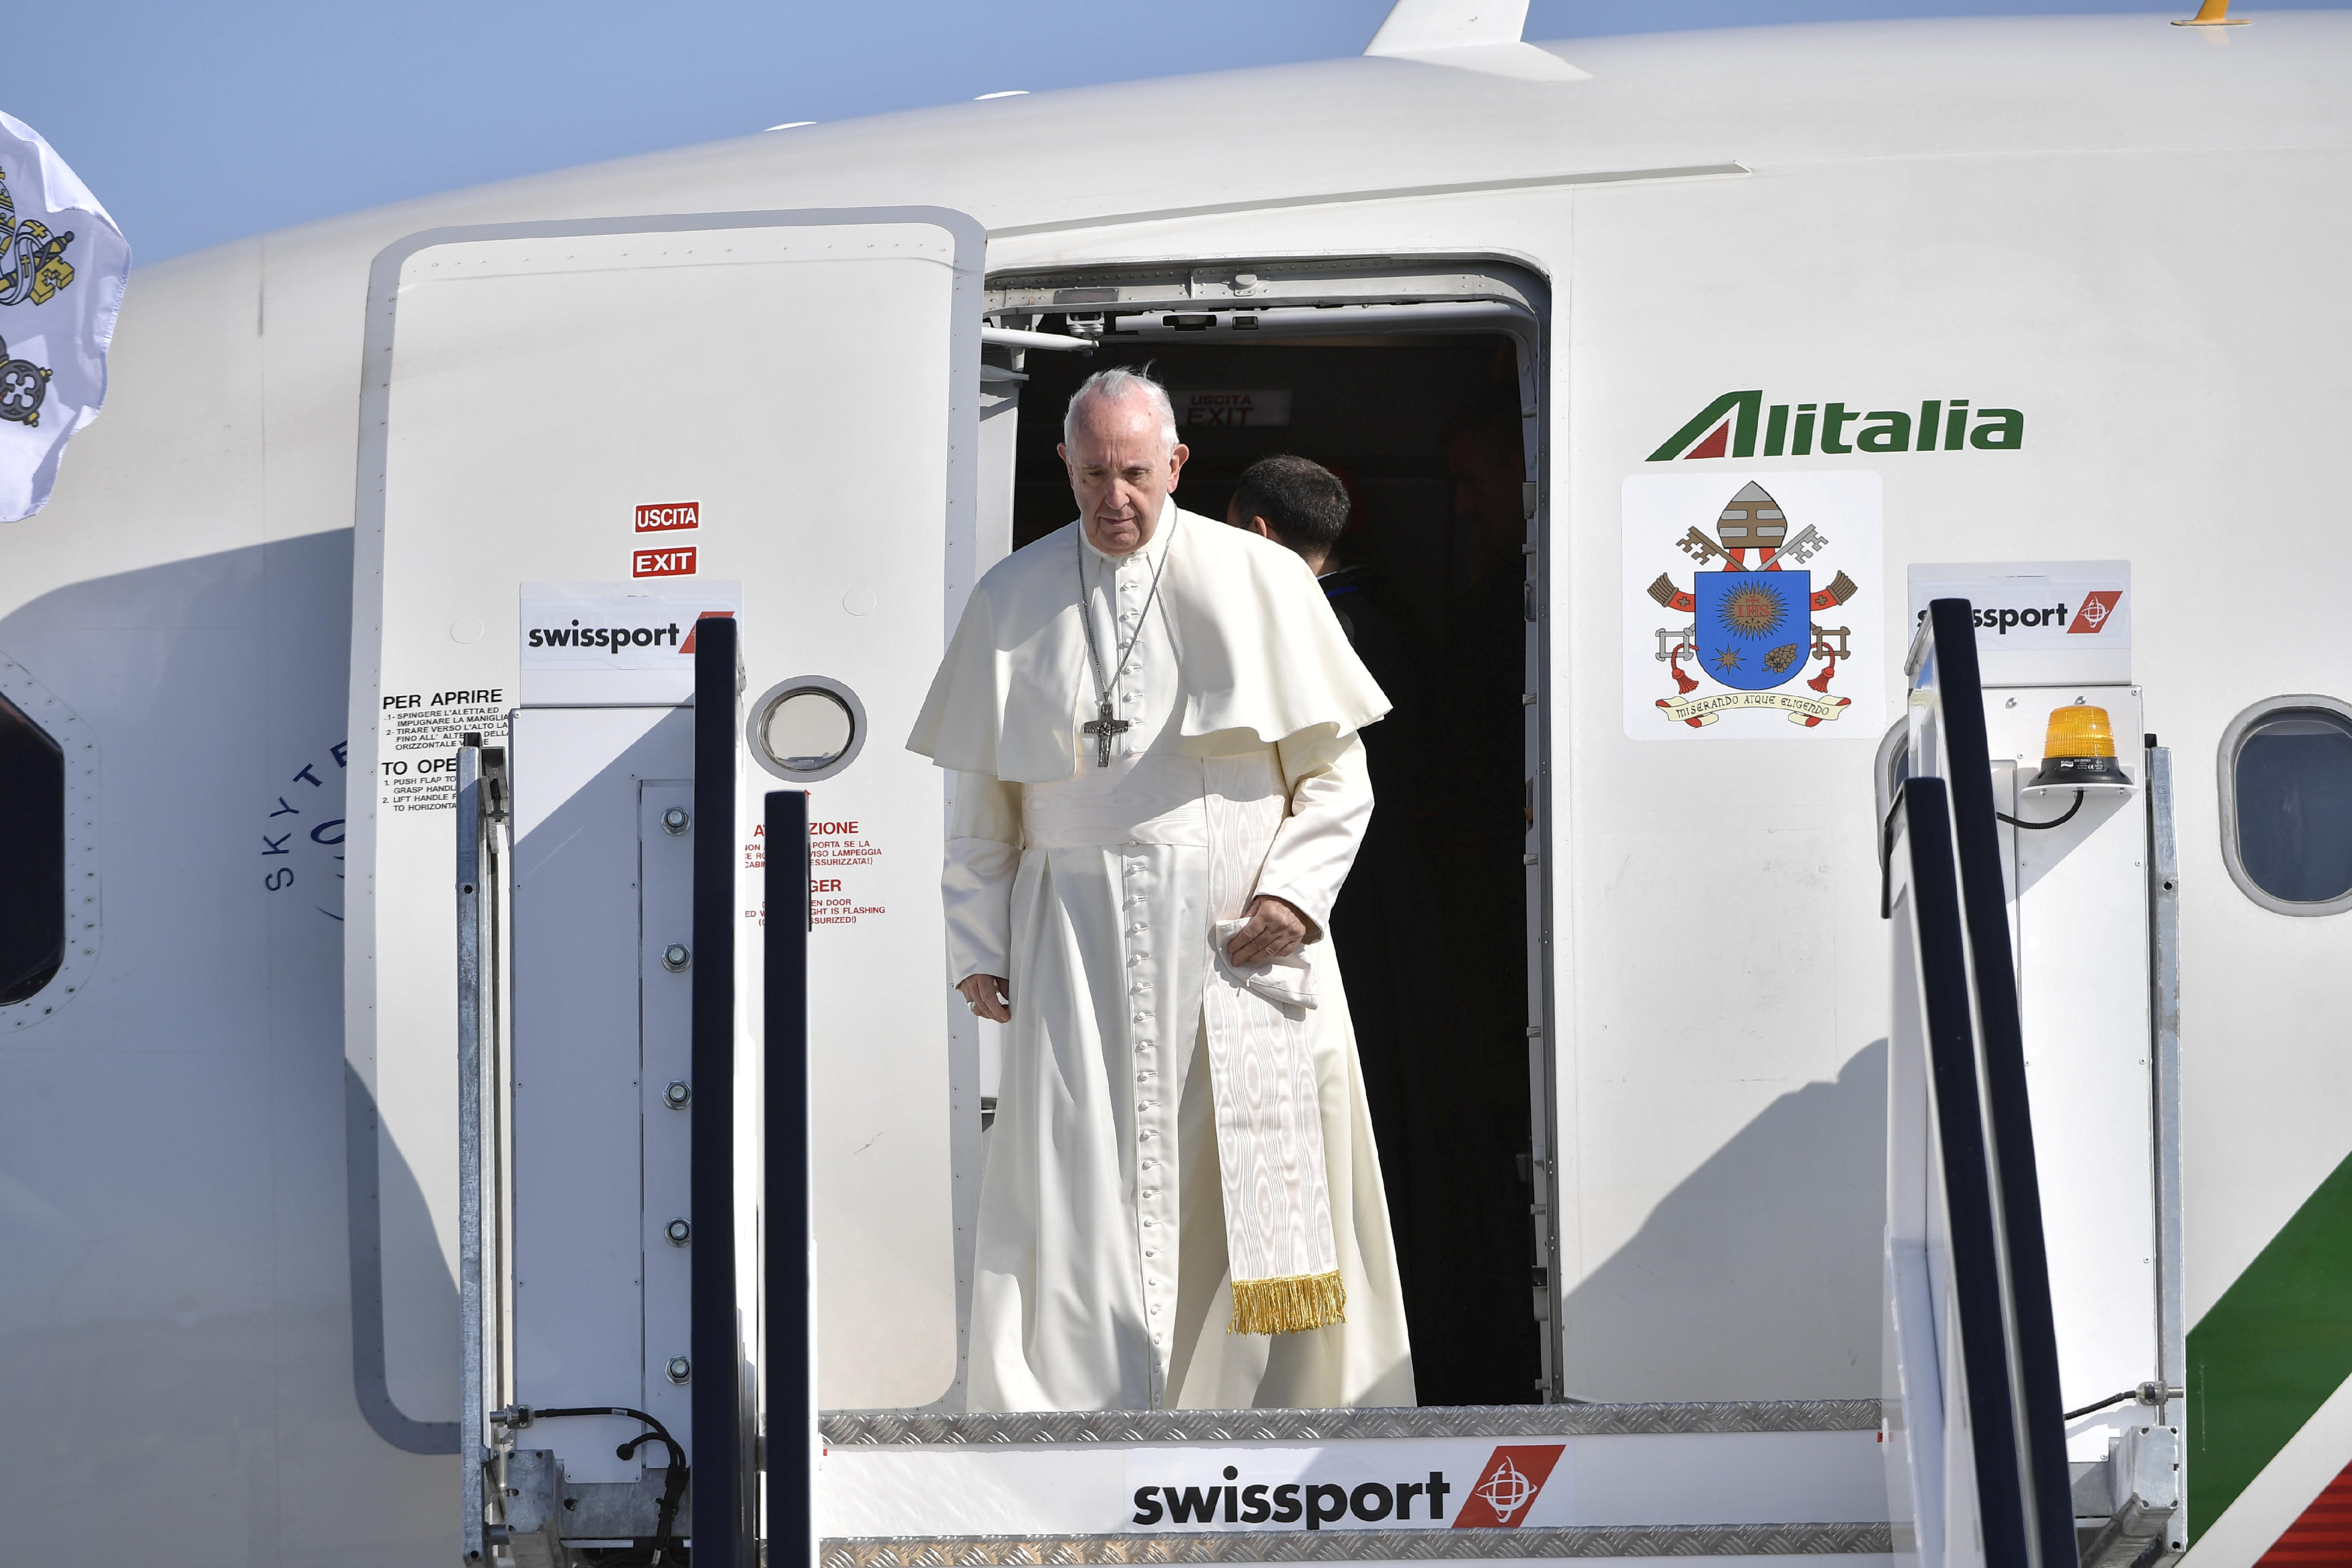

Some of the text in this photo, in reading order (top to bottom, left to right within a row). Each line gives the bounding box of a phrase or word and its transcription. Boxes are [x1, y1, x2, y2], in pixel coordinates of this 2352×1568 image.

[1191, 394, 1252, 405] USCITA
[1186, 407, 1254, 426] EXIT
[1644, 390, 2024, 462] Alitalia
[637, 507, 697, 528] USCITA
[636, 552, 693, 572] EXIT
[1736, 605, 1770, 617] IHS
[528, 619, 679, 654] swissport
[383, 689, 503, 709] PER APRIRE
[1676, 695, 1830, 718] MISERANDO ATQUE ELIGENDO
[397, 710, 442, 720] SPINGERE
[444, 708, 485, 717] L'ALETTA
[397, 718, 451, 728] IMPUGNARE
[466, 713, 509, 723] MANIGLIA
[397, 727, 429, 735] TIRARE
[464, 722, 494, 730] L'ALTO
[396, 741, 456, 750] ORIZZONTALE
[382, 758, 456, 775] TO OPE
[394, 777, 417, 785] PUSH
[408, 803, 457, 811] HORIZONTA
[262, 740, 347, 891] SKYTE
[833, 848, 882, 857] LAMPEGGIA
[810, 858, 873, 866] ESSURIZZATA!)
[810, 879, 841, 892] GER
[843, 906, 886, 914] FLASHING
[1132, 1465, 1450, 1530] swissport
